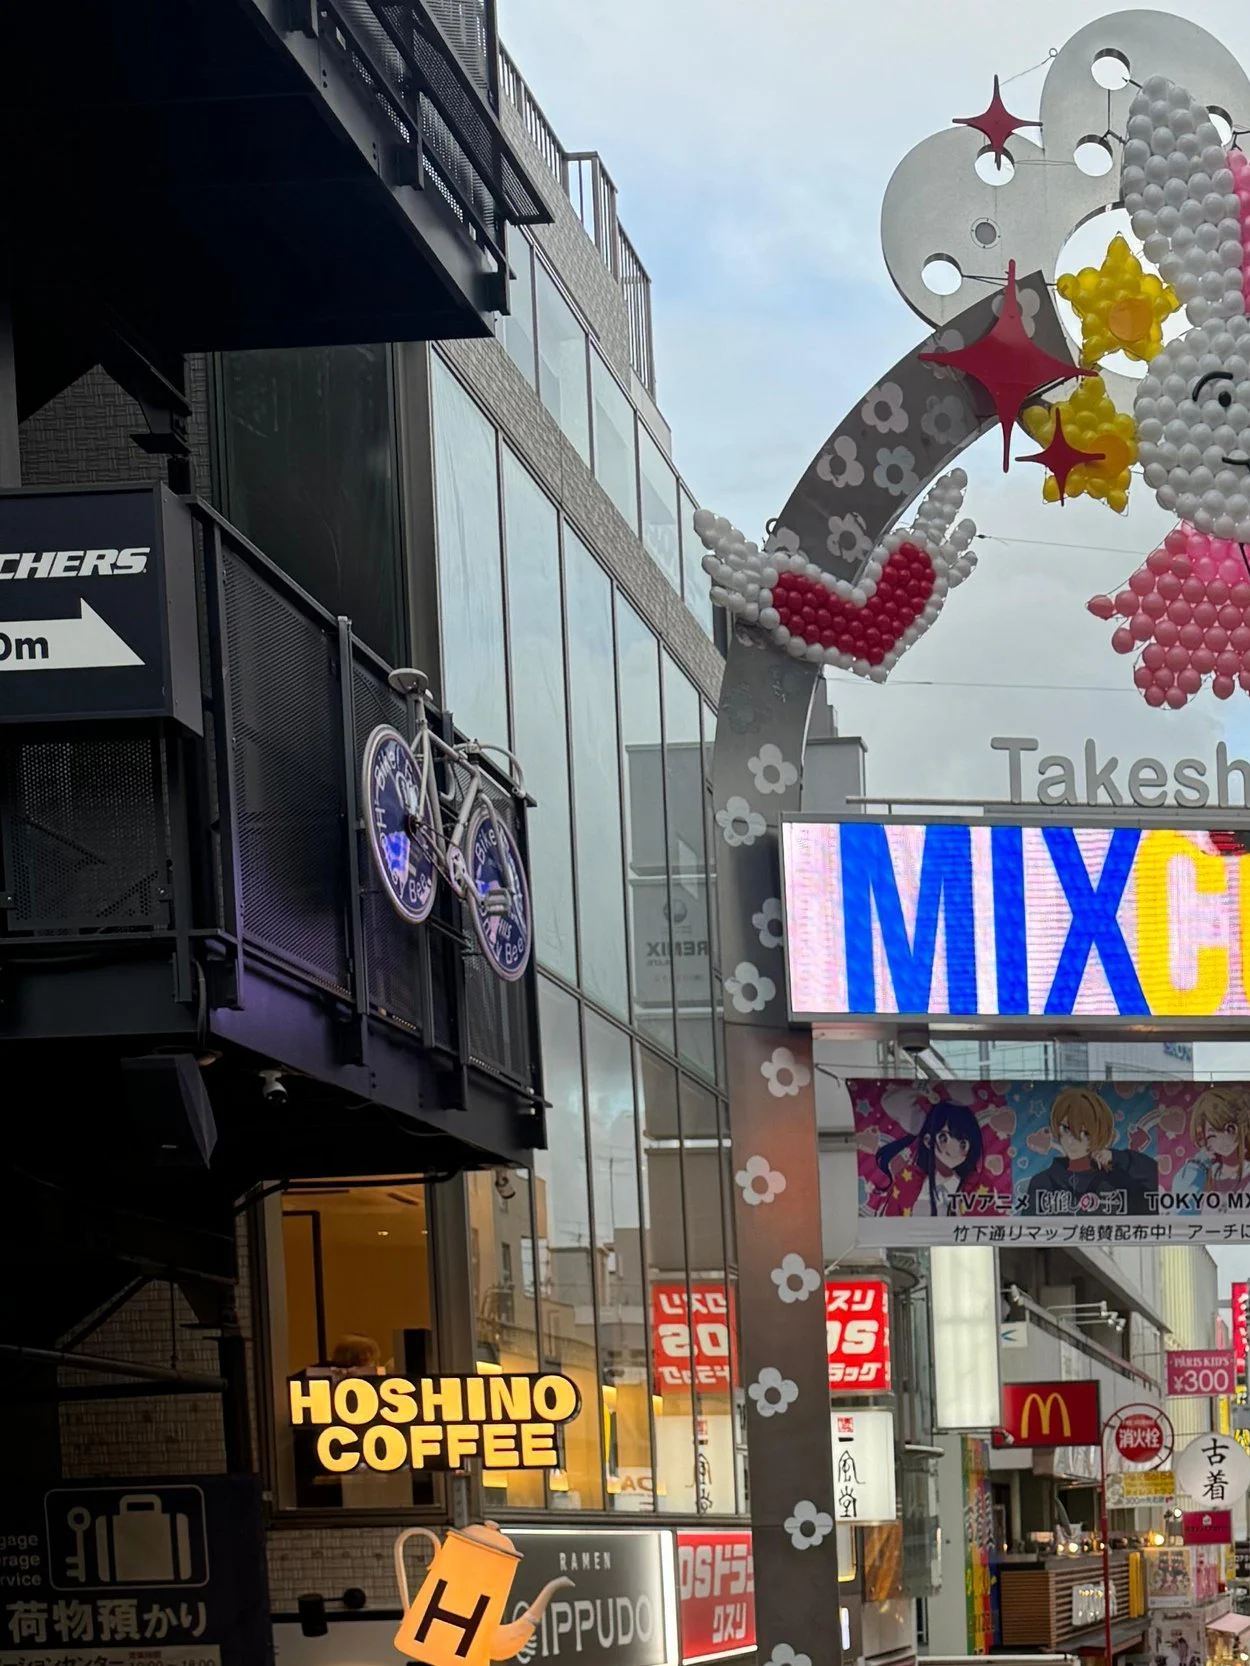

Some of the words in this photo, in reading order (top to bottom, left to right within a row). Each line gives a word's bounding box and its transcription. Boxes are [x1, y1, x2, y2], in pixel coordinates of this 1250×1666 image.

[1147, 1192, 1220, 1211] TOKYO
[825, 1289, 876, 1312] スリ
[289, 1375, 577, 1425] HOSHINO
[1174, 1369, 1229, 1392] ¥300
[316, 1422, 557, 1472] COFFEE
[1119, 1427, 1160, 1449] 消火栓
[1202, 1438, 1229, 1501] 古着
[559, 1551, 611, 1571] RAMEN
[6, 1599, 207, 1643] 荷物預かり
[414, 1578, 491, 1659] H
[712, 1603, 747, 1644] クスリ
